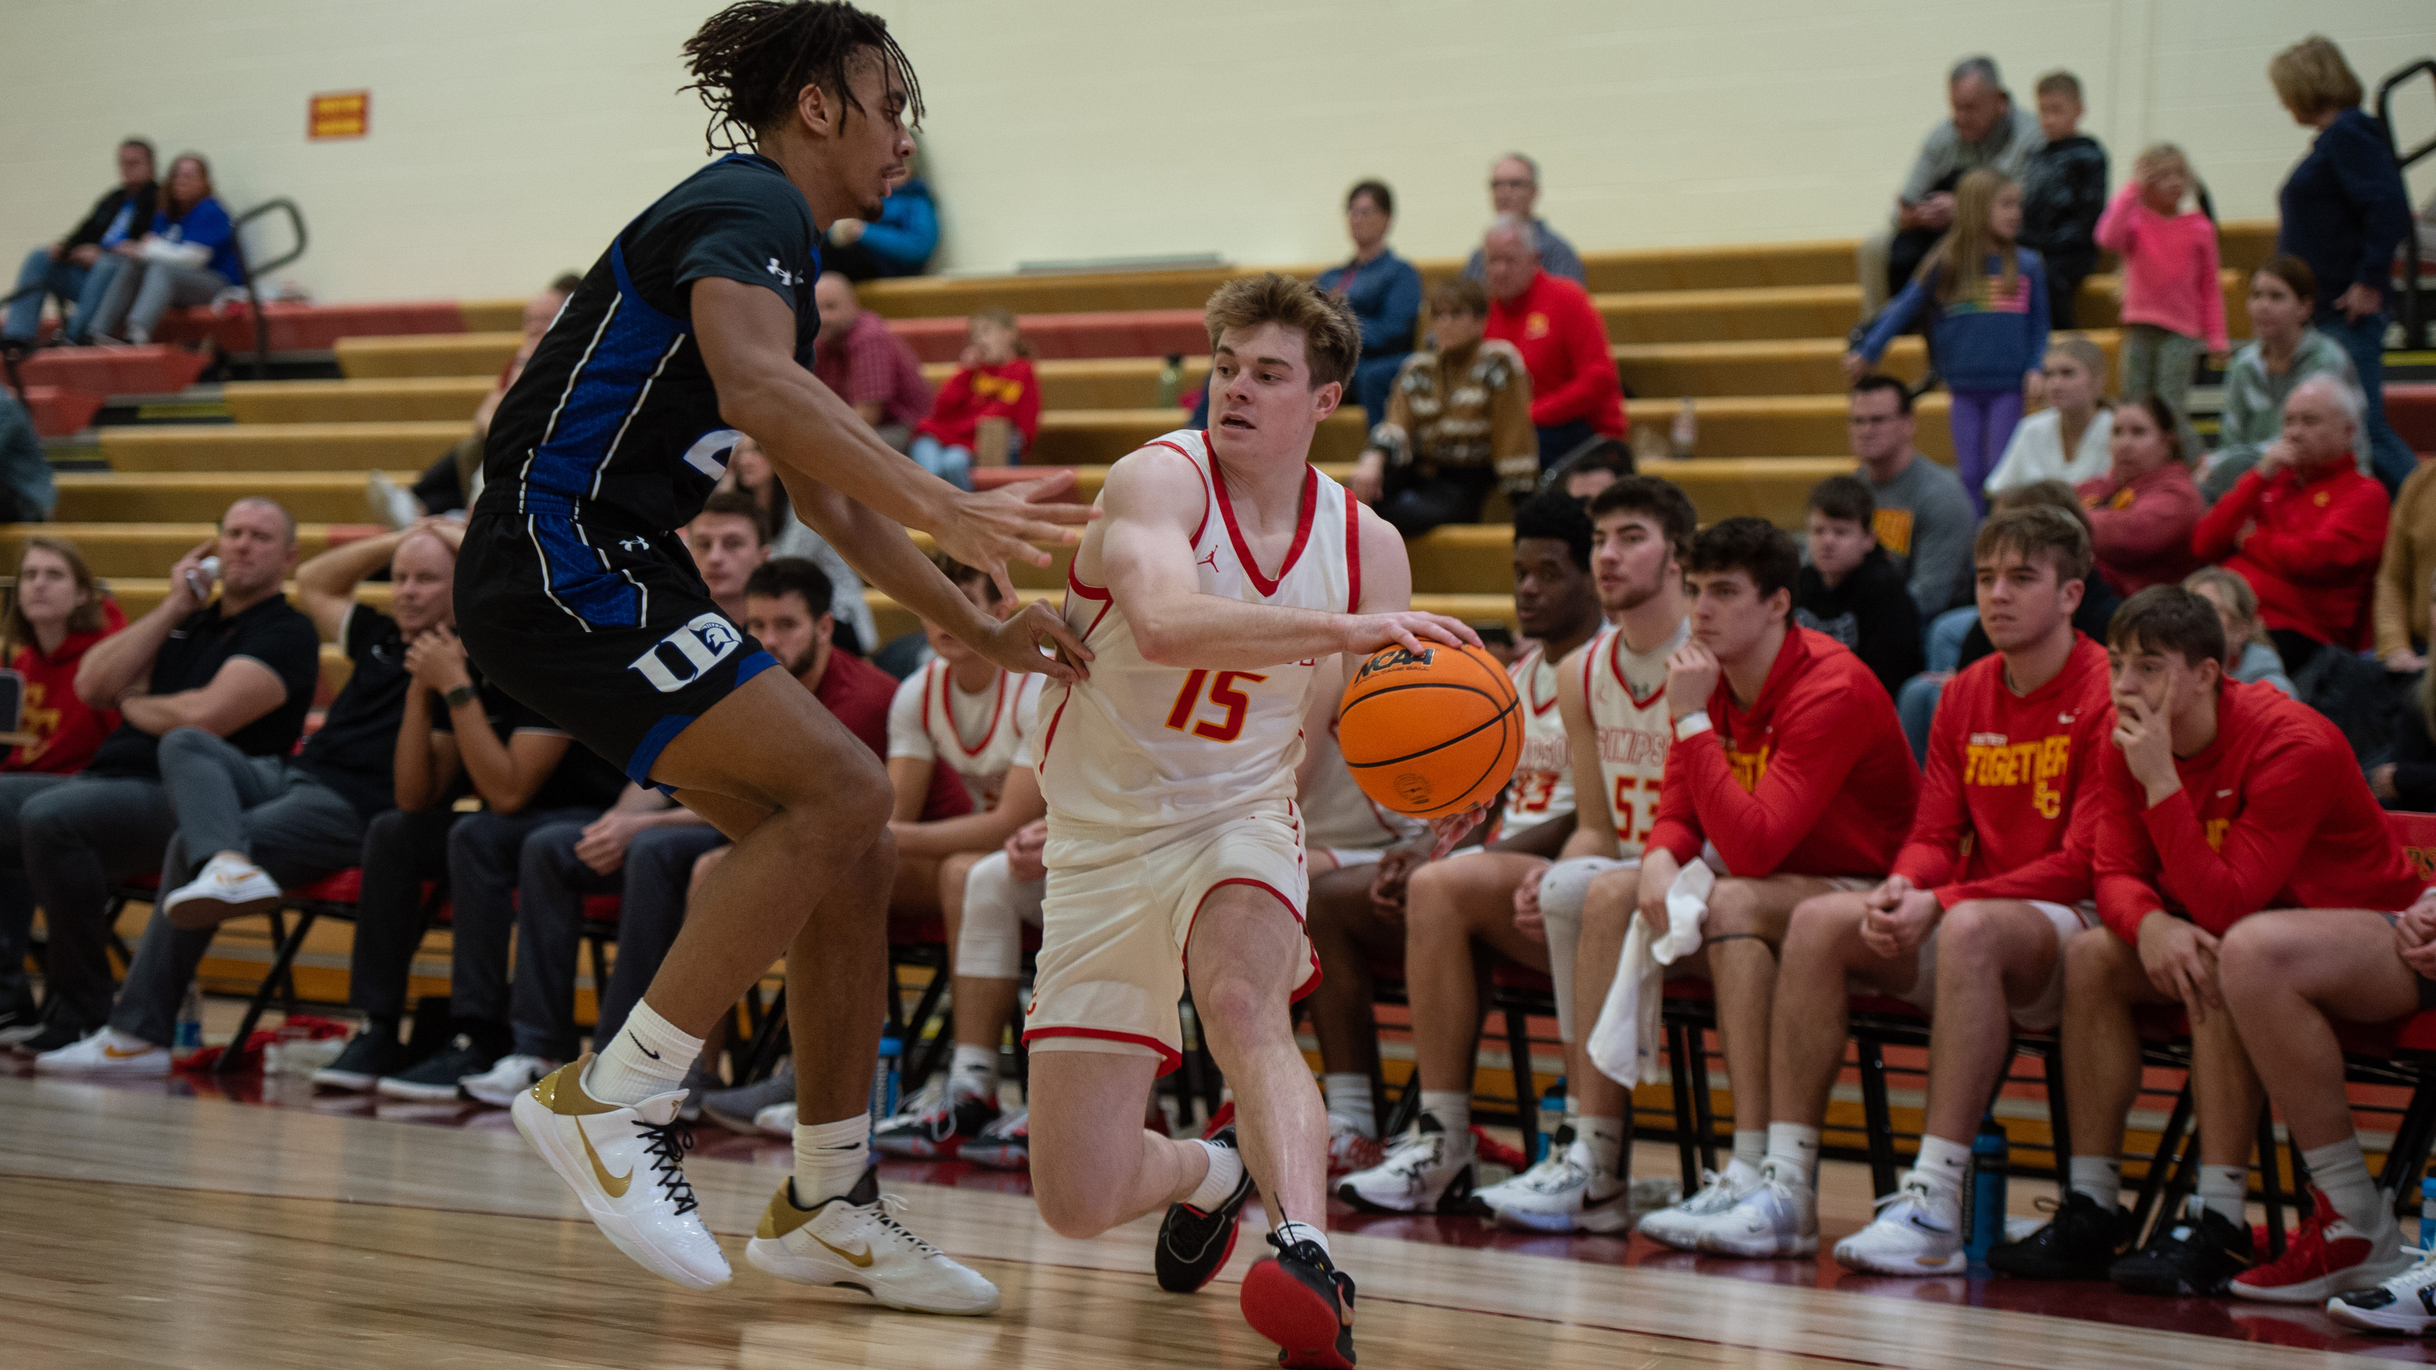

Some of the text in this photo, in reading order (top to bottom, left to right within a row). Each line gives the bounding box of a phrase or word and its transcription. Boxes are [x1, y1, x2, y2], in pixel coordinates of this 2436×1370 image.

[1353, 648, 1436, 686] NCAA
[1164, 668, 1270, 744] 15
[1600, 725, 1672, 767] SIMPS
